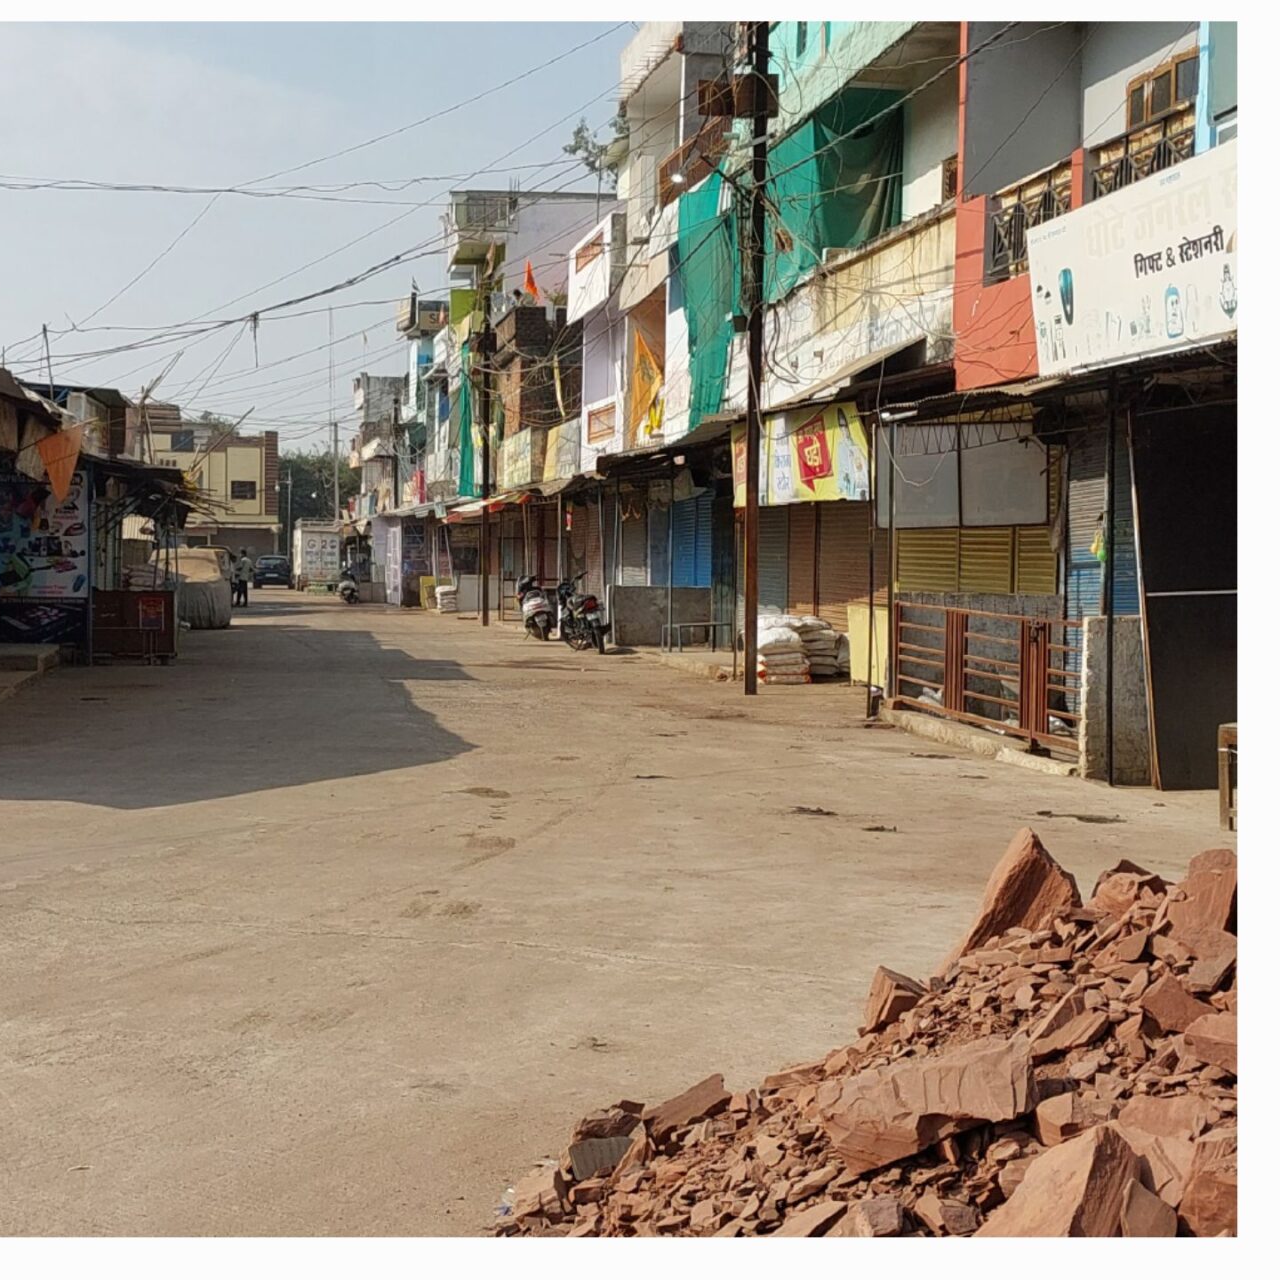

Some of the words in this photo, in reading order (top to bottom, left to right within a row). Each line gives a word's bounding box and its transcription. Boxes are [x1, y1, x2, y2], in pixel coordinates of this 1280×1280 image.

[1133, 252, 1163, 278] गिफ्ट
[1165, 247, 1176, 268] &
[1178, 224, 1225, 264] स्टेशनरी
